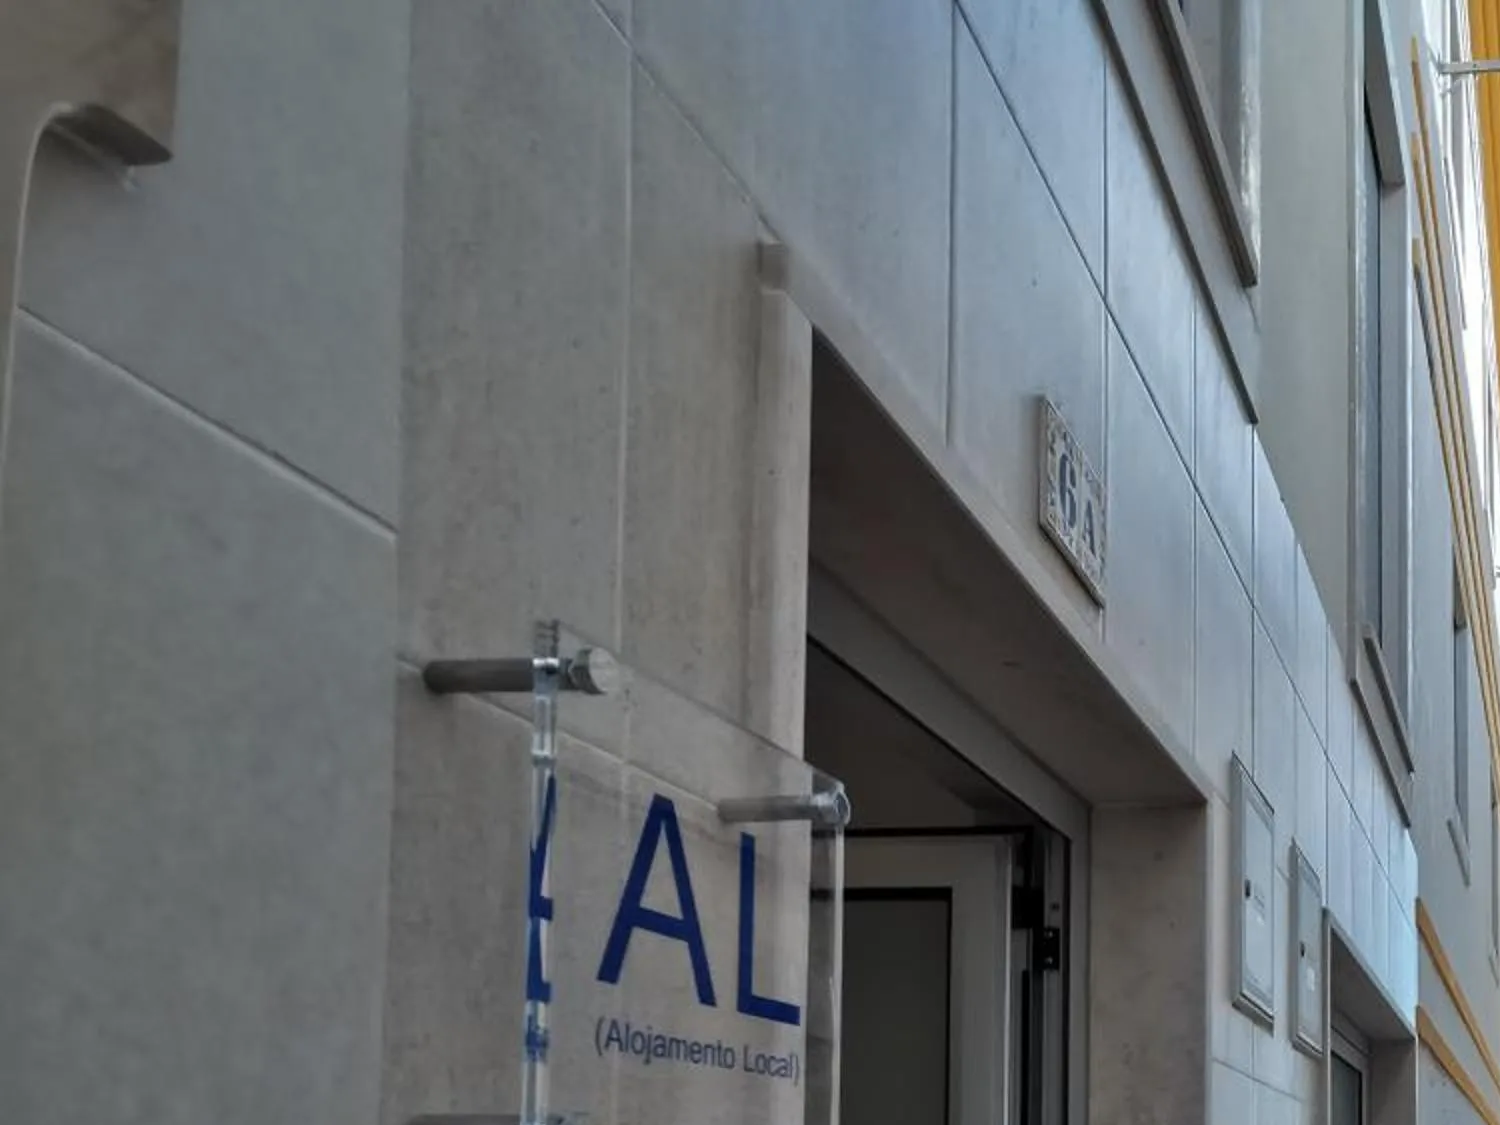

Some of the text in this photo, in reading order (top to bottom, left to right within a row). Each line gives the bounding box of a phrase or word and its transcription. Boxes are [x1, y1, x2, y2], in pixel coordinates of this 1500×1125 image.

[597, 793, 800, 1025] AL
[595, 1016, 800, 1087] (Alojamento Local)
